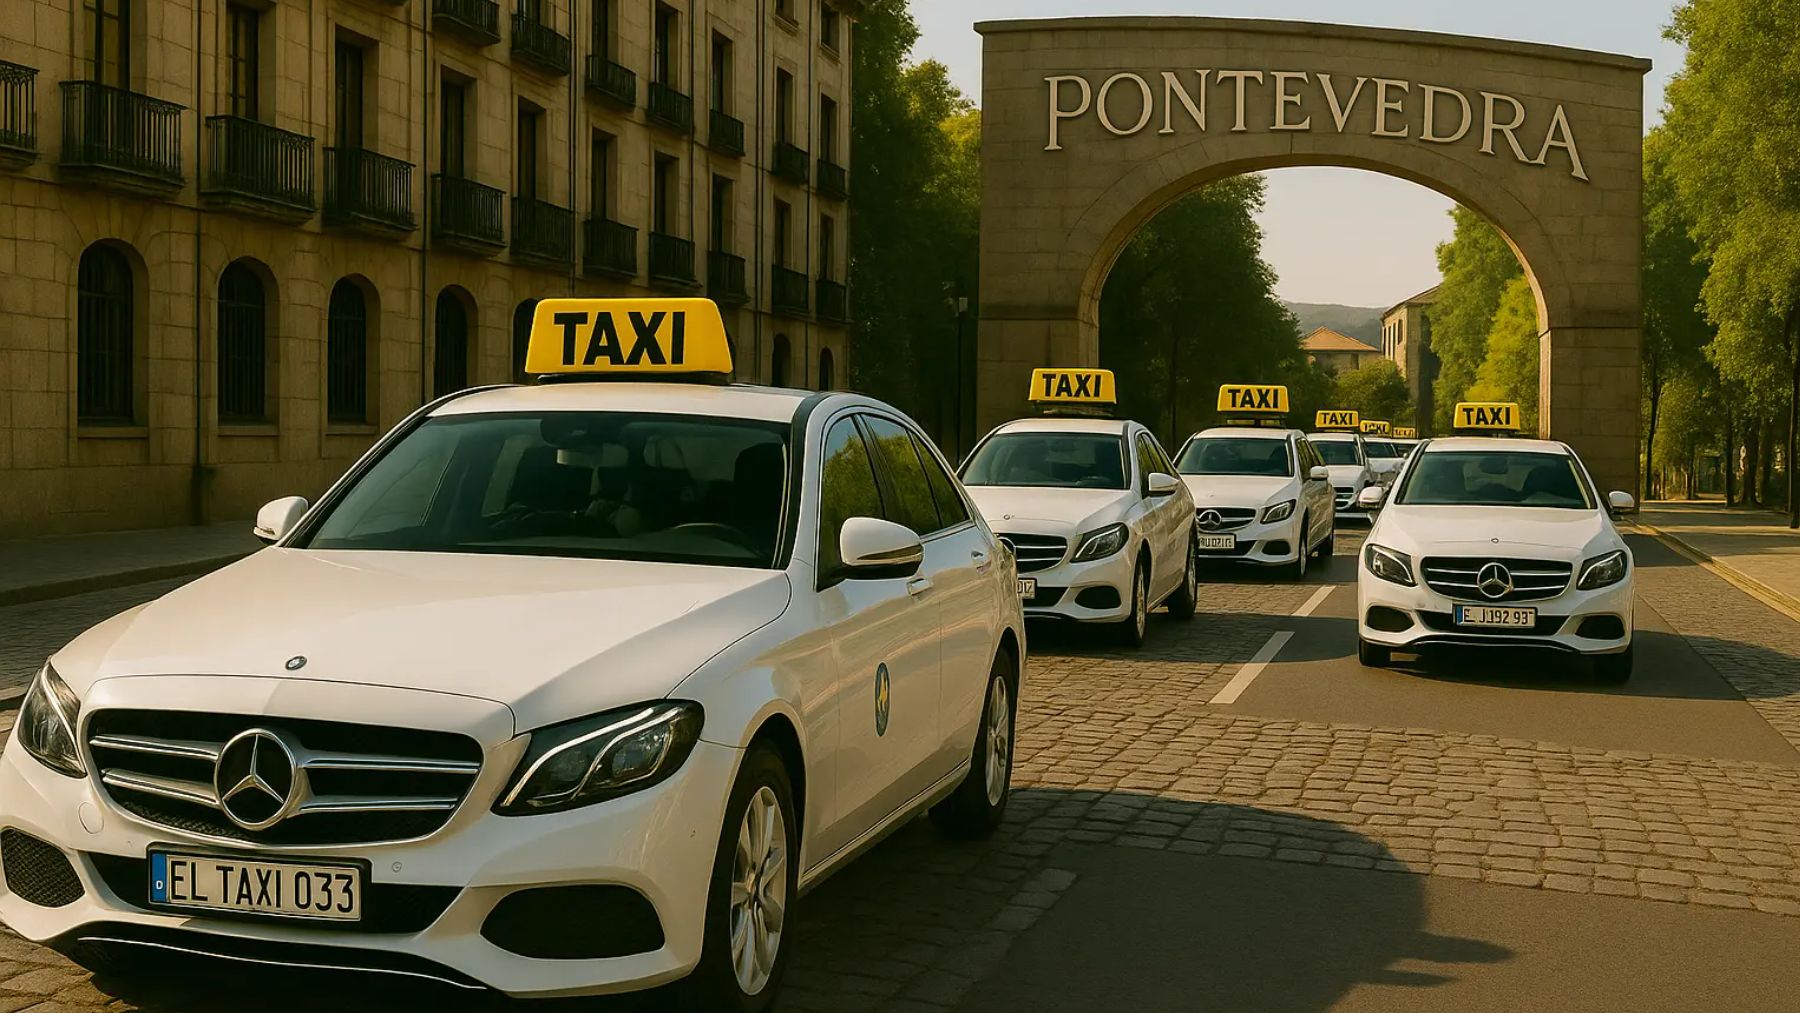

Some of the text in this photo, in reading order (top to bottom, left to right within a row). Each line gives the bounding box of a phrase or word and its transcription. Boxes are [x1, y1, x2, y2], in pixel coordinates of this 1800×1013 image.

[1044, 69, 1590, 182] PONTEVEDRA
[554, 311, 686, 366] TAXI
[1042, 373, 1102, 398] TAXI
[1227, 388, 1279, 409] TAXI
[1321, 412, 1353, 426] TAXI
[1462, 407, 1511, 426] TAXI
[156, 880, 164, 890] D
[171, 860, 354, 914] EL TAXI 033
